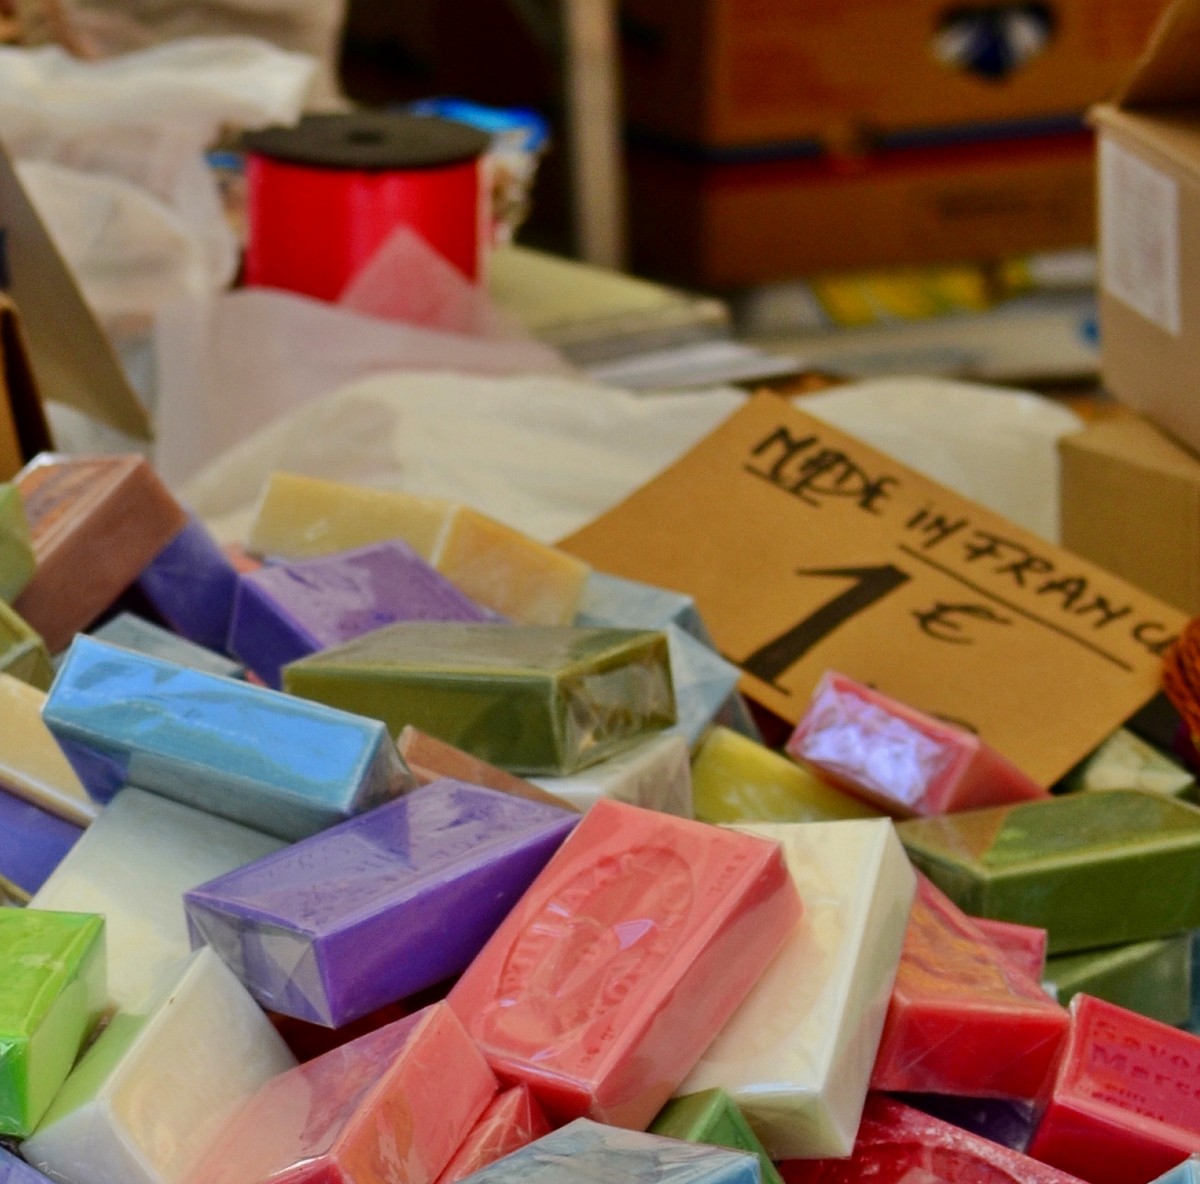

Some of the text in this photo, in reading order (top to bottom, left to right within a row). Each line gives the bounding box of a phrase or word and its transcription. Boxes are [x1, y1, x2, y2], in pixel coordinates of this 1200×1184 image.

[738, 563, 1014, 697] 1 €
[750, 425, 1179, 655] MADE IN FRANC
